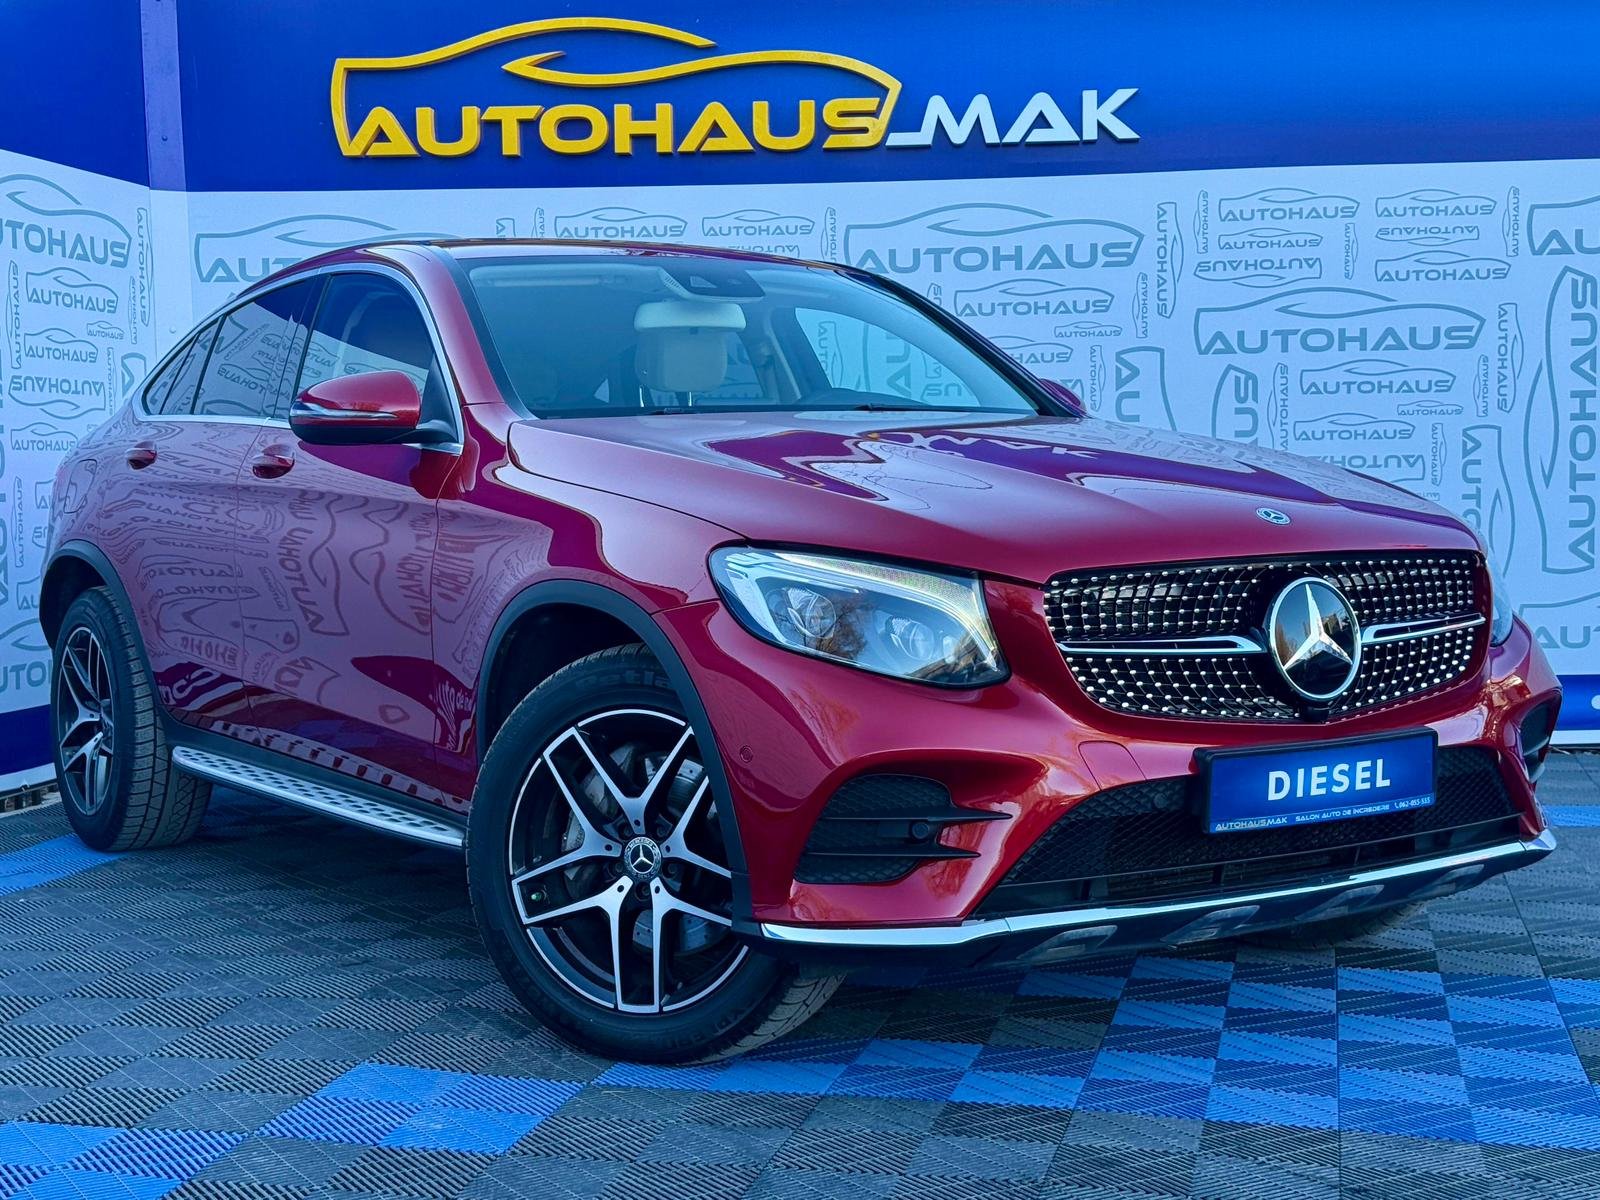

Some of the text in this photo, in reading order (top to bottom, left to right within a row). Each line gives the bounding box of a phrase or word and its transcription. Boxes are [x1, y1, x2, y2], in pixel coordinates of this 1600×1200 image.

[340, 87, 1140, 158] AUTOHAUS MAK
[1220, 205, 1357, 222] AUTOHAUS
[1376, 203, 1493, 217] AUTOHAUS
[559, 225, 684, 239] AUTOHAUS
[703, 223, 814, 237] AUTOHAUS
[1219, 236, 1321, 250] AUTOHAUS
[851, 241, 1140, 274] AUTOHAUS
[1375, 266, 1509, 282] AUTOHAUS
[28, 287, 118, 314] AUTOHAUS
[956, 299, 1112, 318] AUTOHAUS
[1055, 328, 1122, 339] AUTOHAUS
[1200, 324, 1481, 356] AUTOHAUS
[27, 346, 97, 363] AUTOHAUS
[1302, 378, 1454, 395] AUTOHAUS
[1398, 407, 1463, 417] AUTOHAUS
[1569, 272, 1598, 571] AUTOHAUS
[1295, 425, 1415, 441] AUTOHAUS
[1267, 758, 1391, 801] DIESEL
